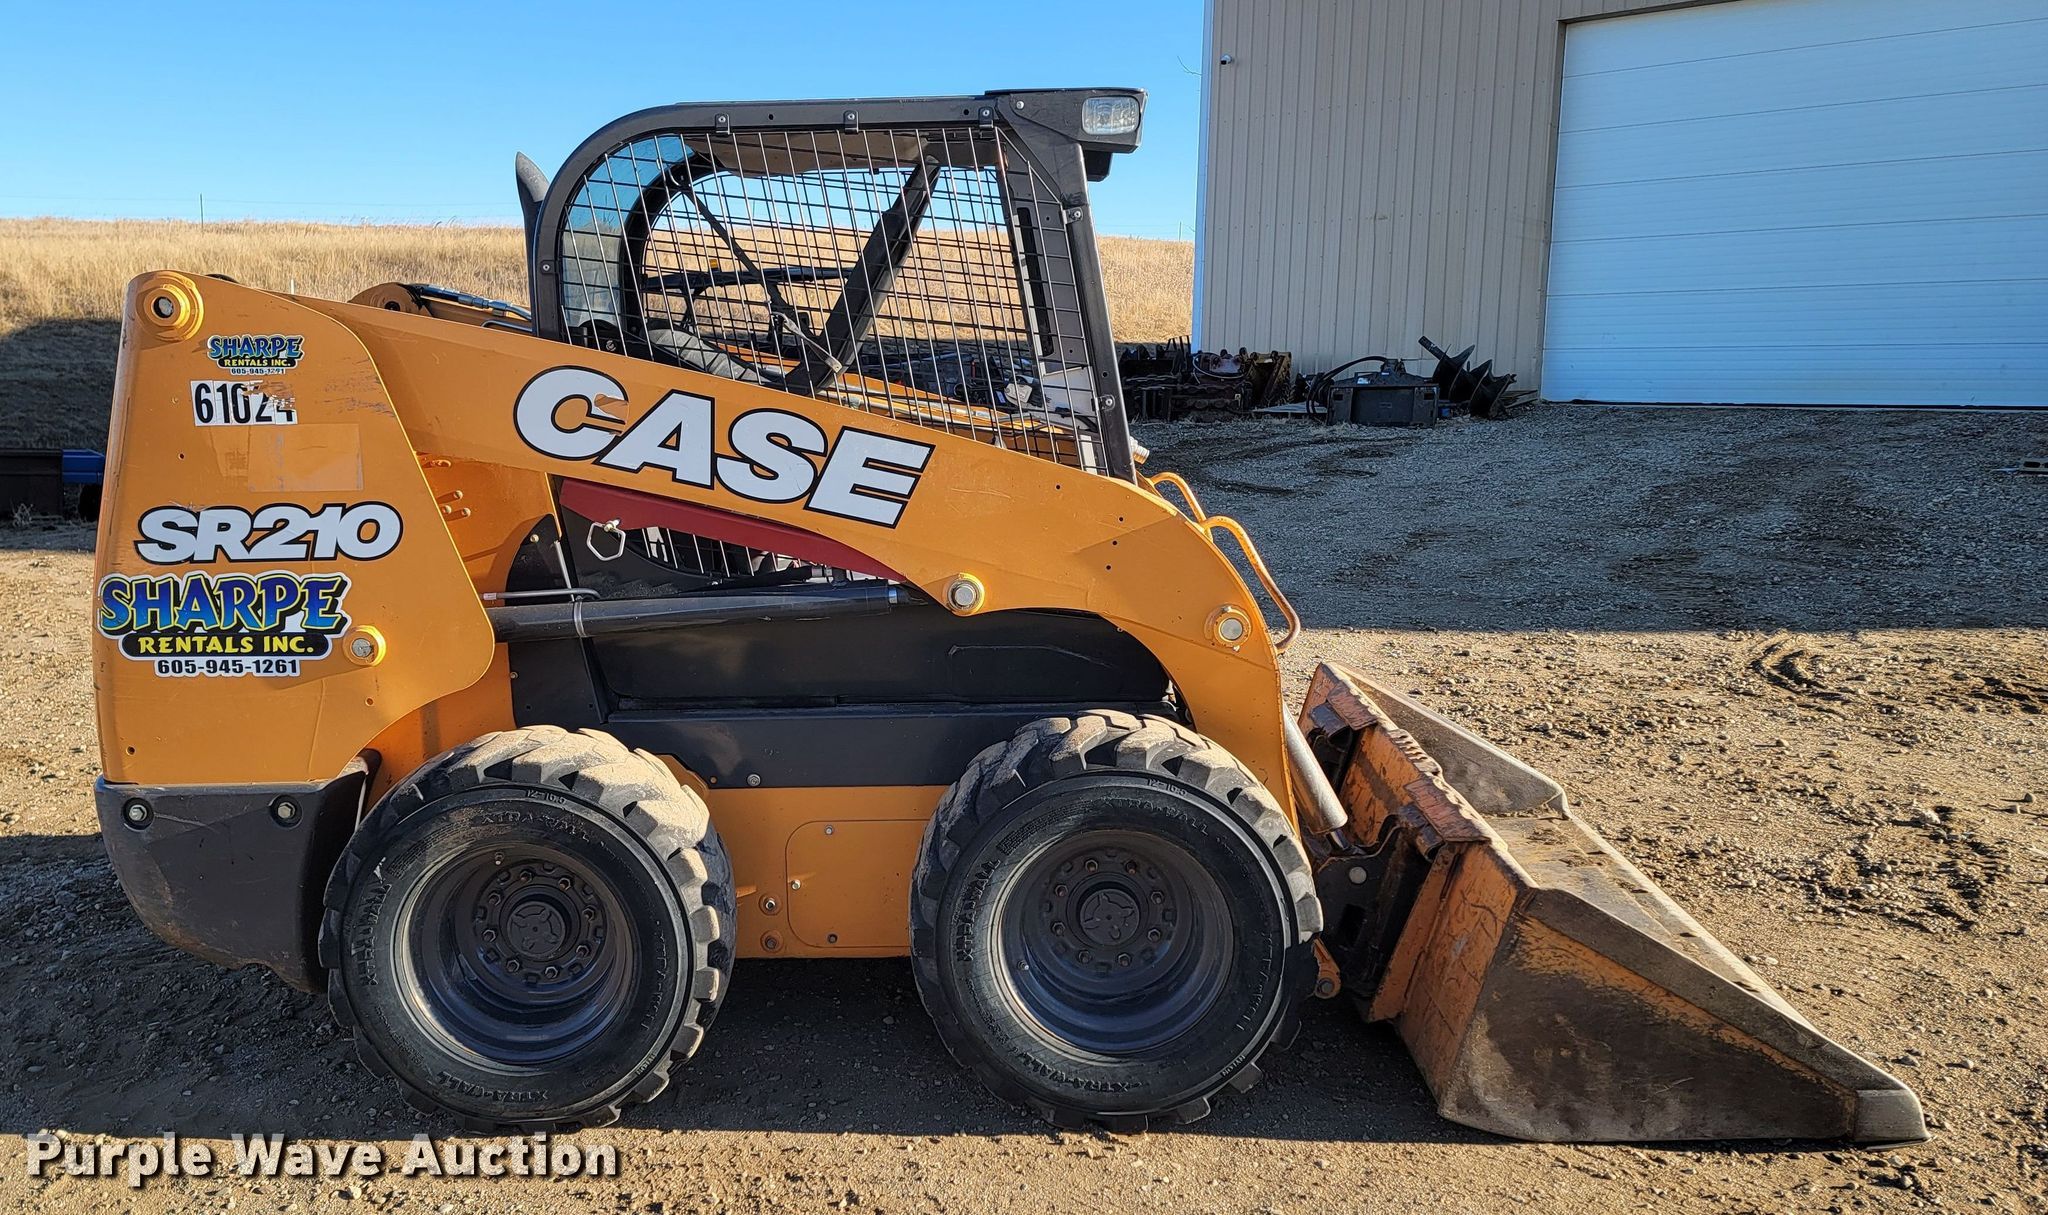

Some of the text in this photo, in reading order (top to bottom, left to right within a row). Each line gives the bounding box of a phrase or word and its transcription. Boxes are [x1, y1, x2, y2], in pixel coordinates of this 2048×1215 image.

[209, 335, 303, 359] SHARPE
[224, 359, 291, 367] RENTALS INC.
[513, 365, 937, 529] CASE
[134, 501, 404, 565] SR210
[100, 573, 352, 635] SHARPE
[138, 634, 315, 654] RENTALS INC.
[157, 659, 299, 675] 605-945-1261
